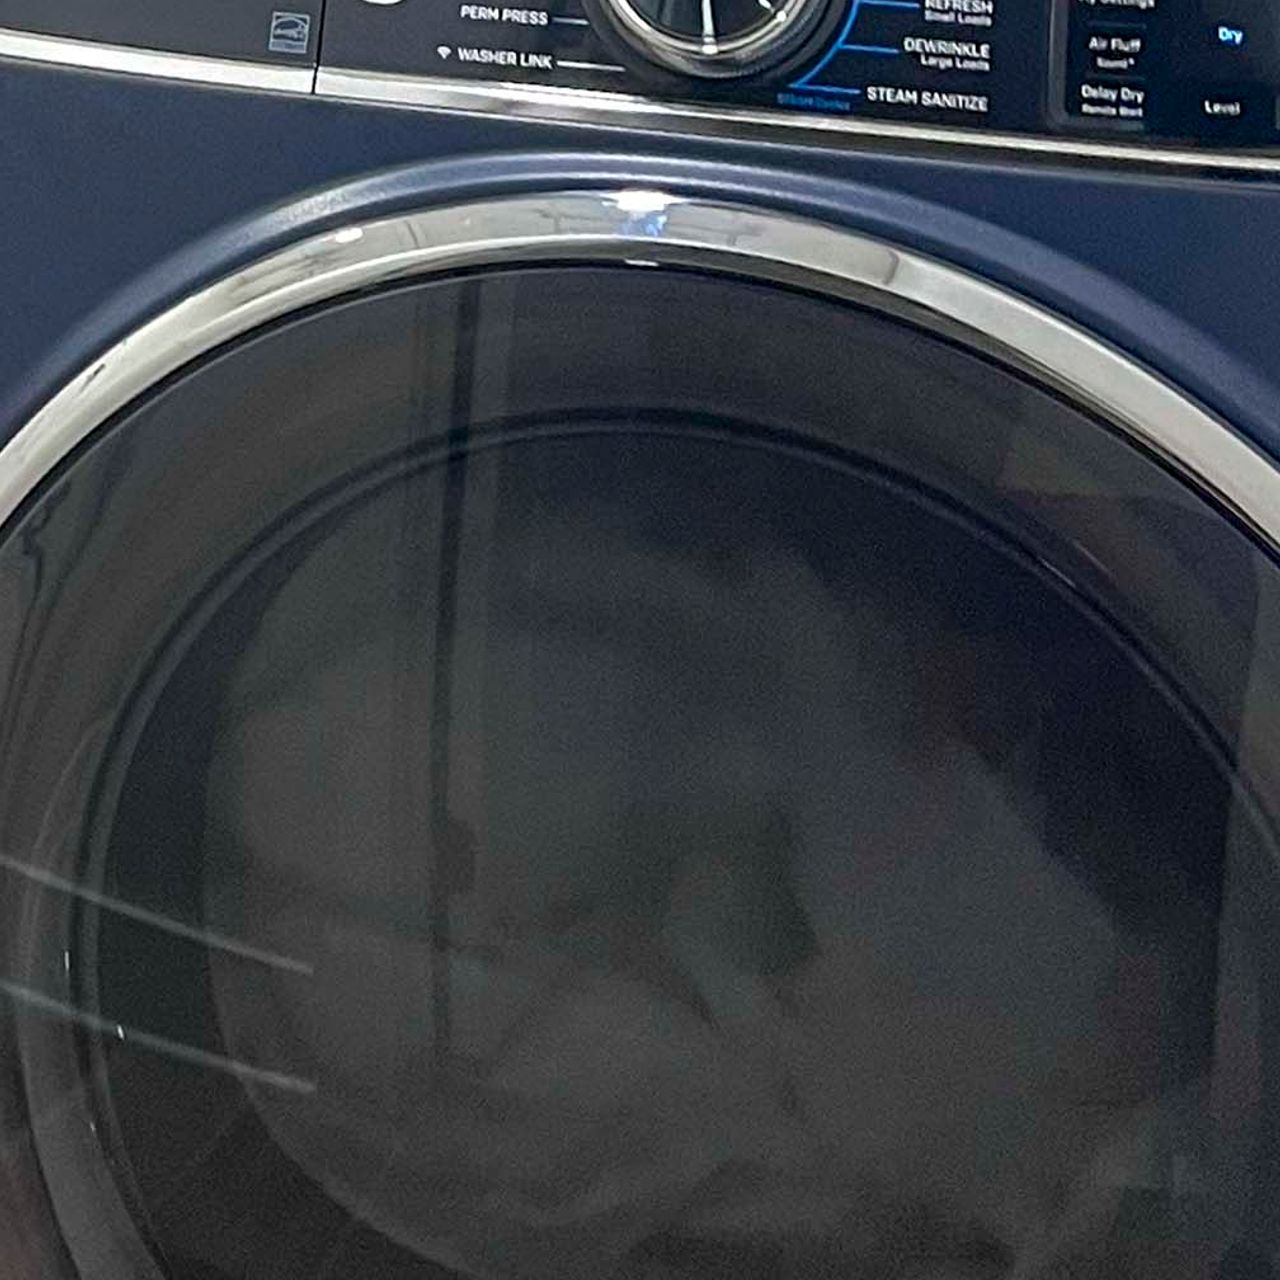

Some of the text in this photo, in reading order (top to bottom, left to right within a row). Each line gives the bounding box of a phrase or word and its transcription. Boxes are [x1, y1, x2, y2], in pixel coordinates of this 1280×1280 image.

[460, 5, 548, 26] PERM PRESS
[1089, 36, 1142, 53] Air Fluff
[1218, 26, 1243, 45] Dry
[903, 36, 990, 59] DEWRINKLE
[457, 47, 553, 69] WASHER LINK
[921, 54, 990, 71] Large Loads
[867, 85, 989, 112] STEAM SANITIZE
[1081, 84, 1145, 103] Delay Dry
[1204, 100, 1241, 116] Level
